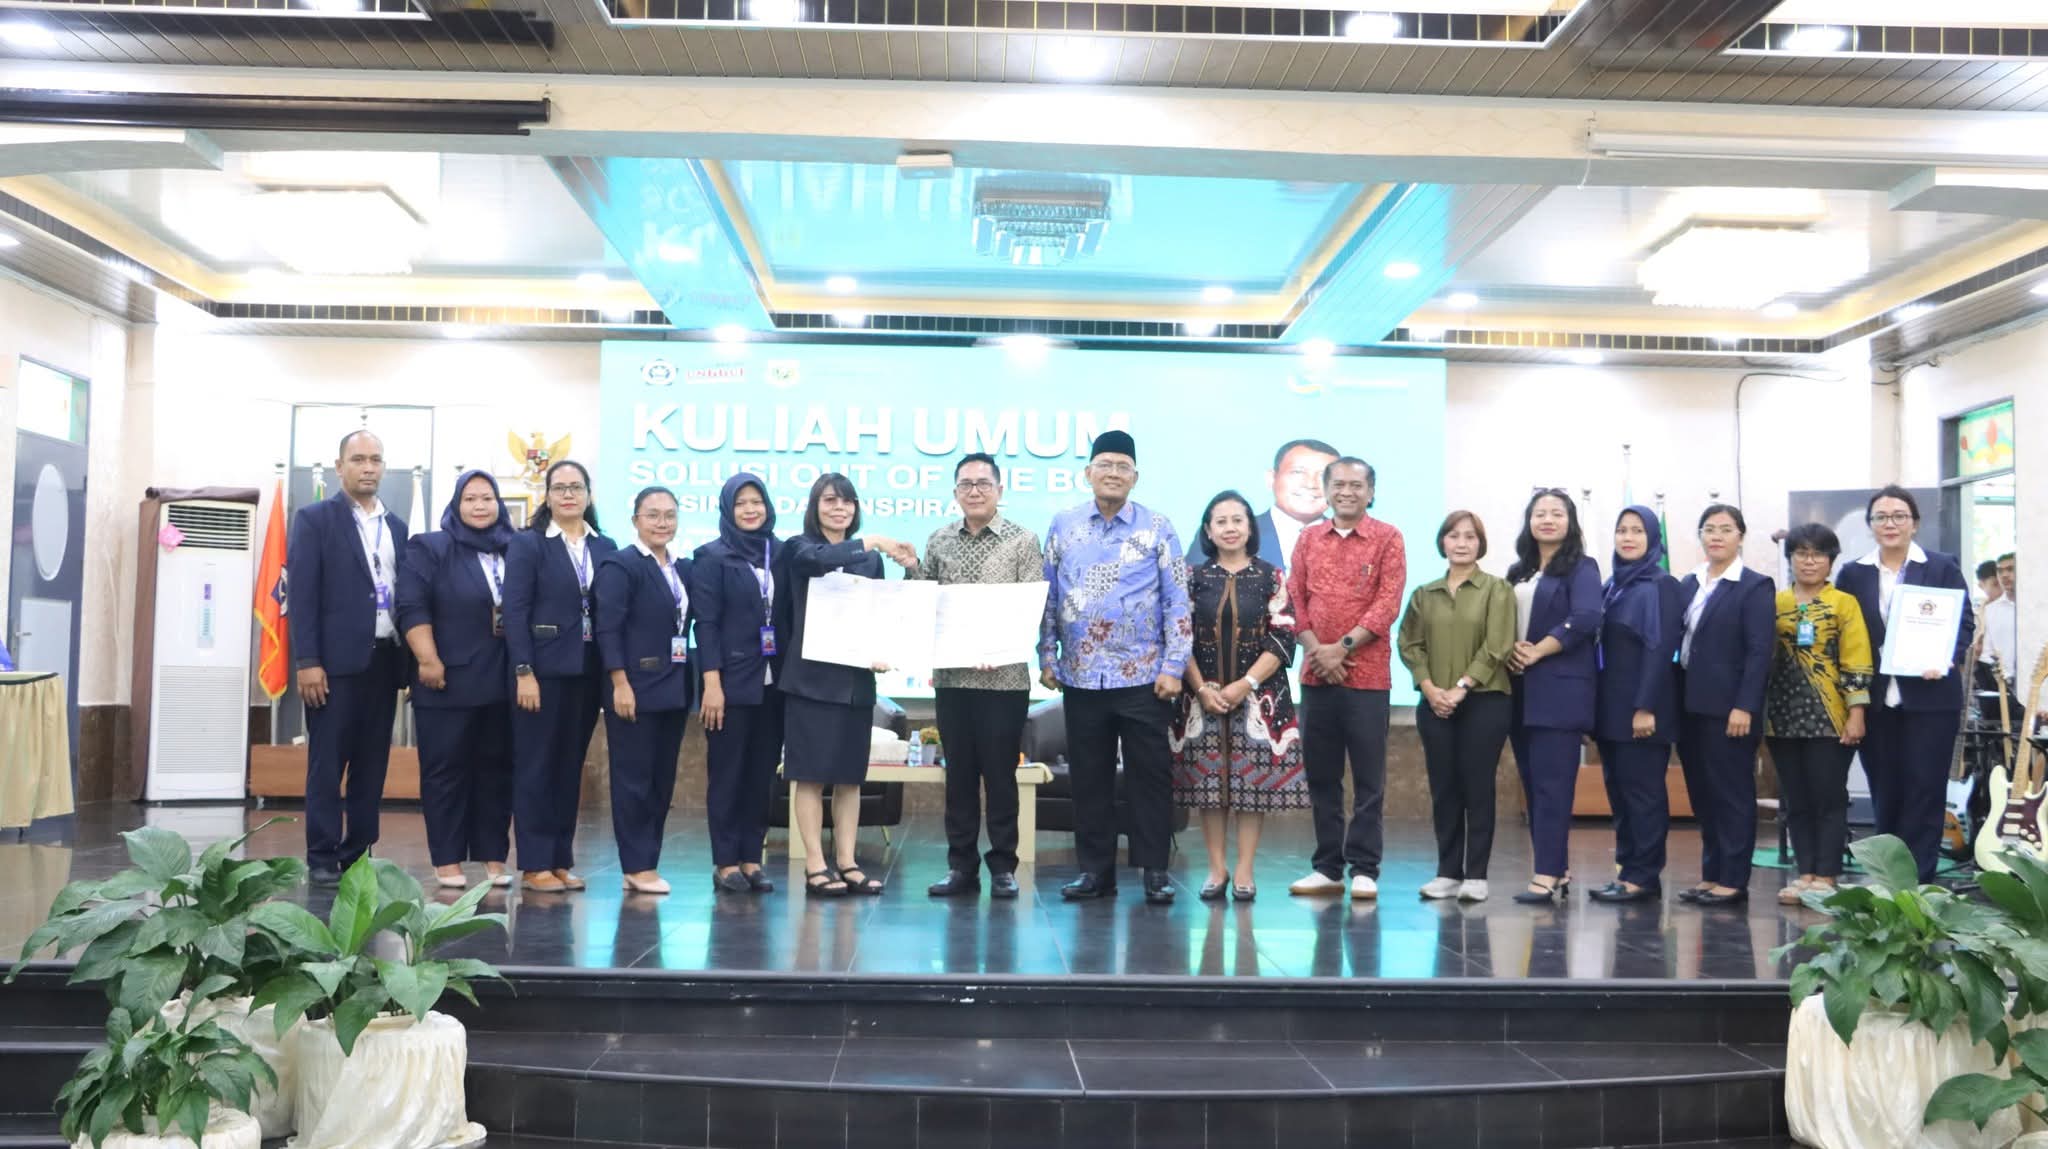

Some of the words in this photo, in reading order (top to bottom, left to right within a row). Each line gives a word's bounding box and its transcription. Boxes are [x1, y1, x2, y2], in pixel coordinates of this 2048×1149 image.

[632, 403, 892, 453] KULIAH
[913, 406, 1131, 458] UMUM
[630, 461, 778, 487] SOLUSI
[887, 464, 945, 489] OF
[777, 496, 808, 515] DA
